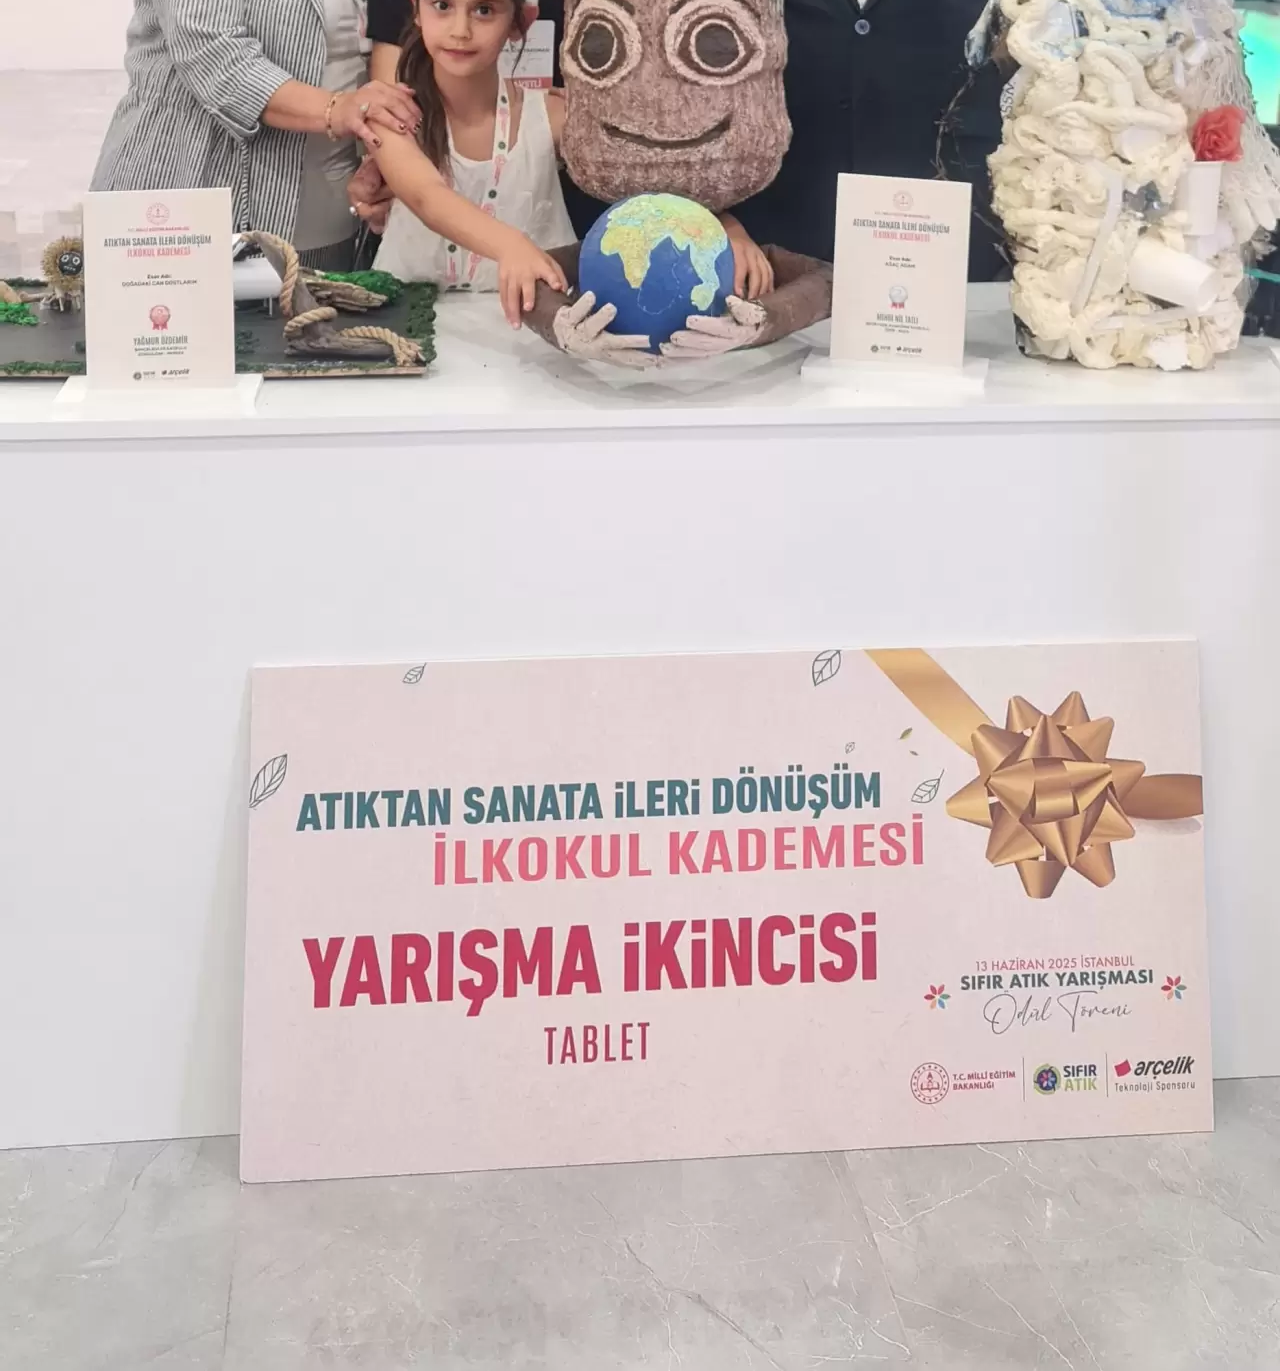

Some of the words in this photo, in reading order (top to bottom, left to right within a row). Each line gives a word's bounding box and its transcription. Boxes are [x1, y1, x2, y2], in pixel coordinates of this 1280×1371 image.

[103, 237, 131, 247] ATIKTAN
[132, 236, 158, 246] SANATA
[159, 234, 176, 246] İLERİ
[177, 234, 212, 247] DÖNÜŞÜM
[127, 247, 155, 258] İLKOKUL
[156, 246, 191, 257] KADEMESİ
[296, 788, 451, 831] ATIKTAN
[463, 782, 603, 825] SANATA
[712, 763, 881, 818] DÖNÜŞÜM
[433, 832, 652, 886] İLKOKUL
[668, 813, 924, 876] KADEMESİ
[302, 925, 602, 1017] YARIŞMA
[975, 961, 988, 972] 13
[991, 957, 1045, 971] HAZİRAN
[1048, 958, 1078, 969] 2025
[1080, 954, 1135, 969] İSTANBUL
[960, 975, 1004, 991] SIFIR
[1009, 973, 1050, 989] ATIK
[1055, 969, 1154, 990] YARIŞMASI
[983, 990, 1053, 1035] Ödül
[1056, 990, 1133, 1033] Töreni
[544, 1022, 650, 1065] TABLET
[952, 1073, 966, 1081] T.C.
[967, 1071, 988, 1080] MİLLİ
[989, 1069, 1016, 1080] EĞİTİM
[1063, 1064, 1097, 1078] SIFIR
[1134, 1055, 1195, 1080] arçelik
[953, 1080, 995, 1090] BAKANLIĞI
[1064, 1078, 1097, 1092] ATIK
[1115, 1082, 1153, 1093] Teknoloji
[1156, 1080, 1196, 1092] Sponsoru
